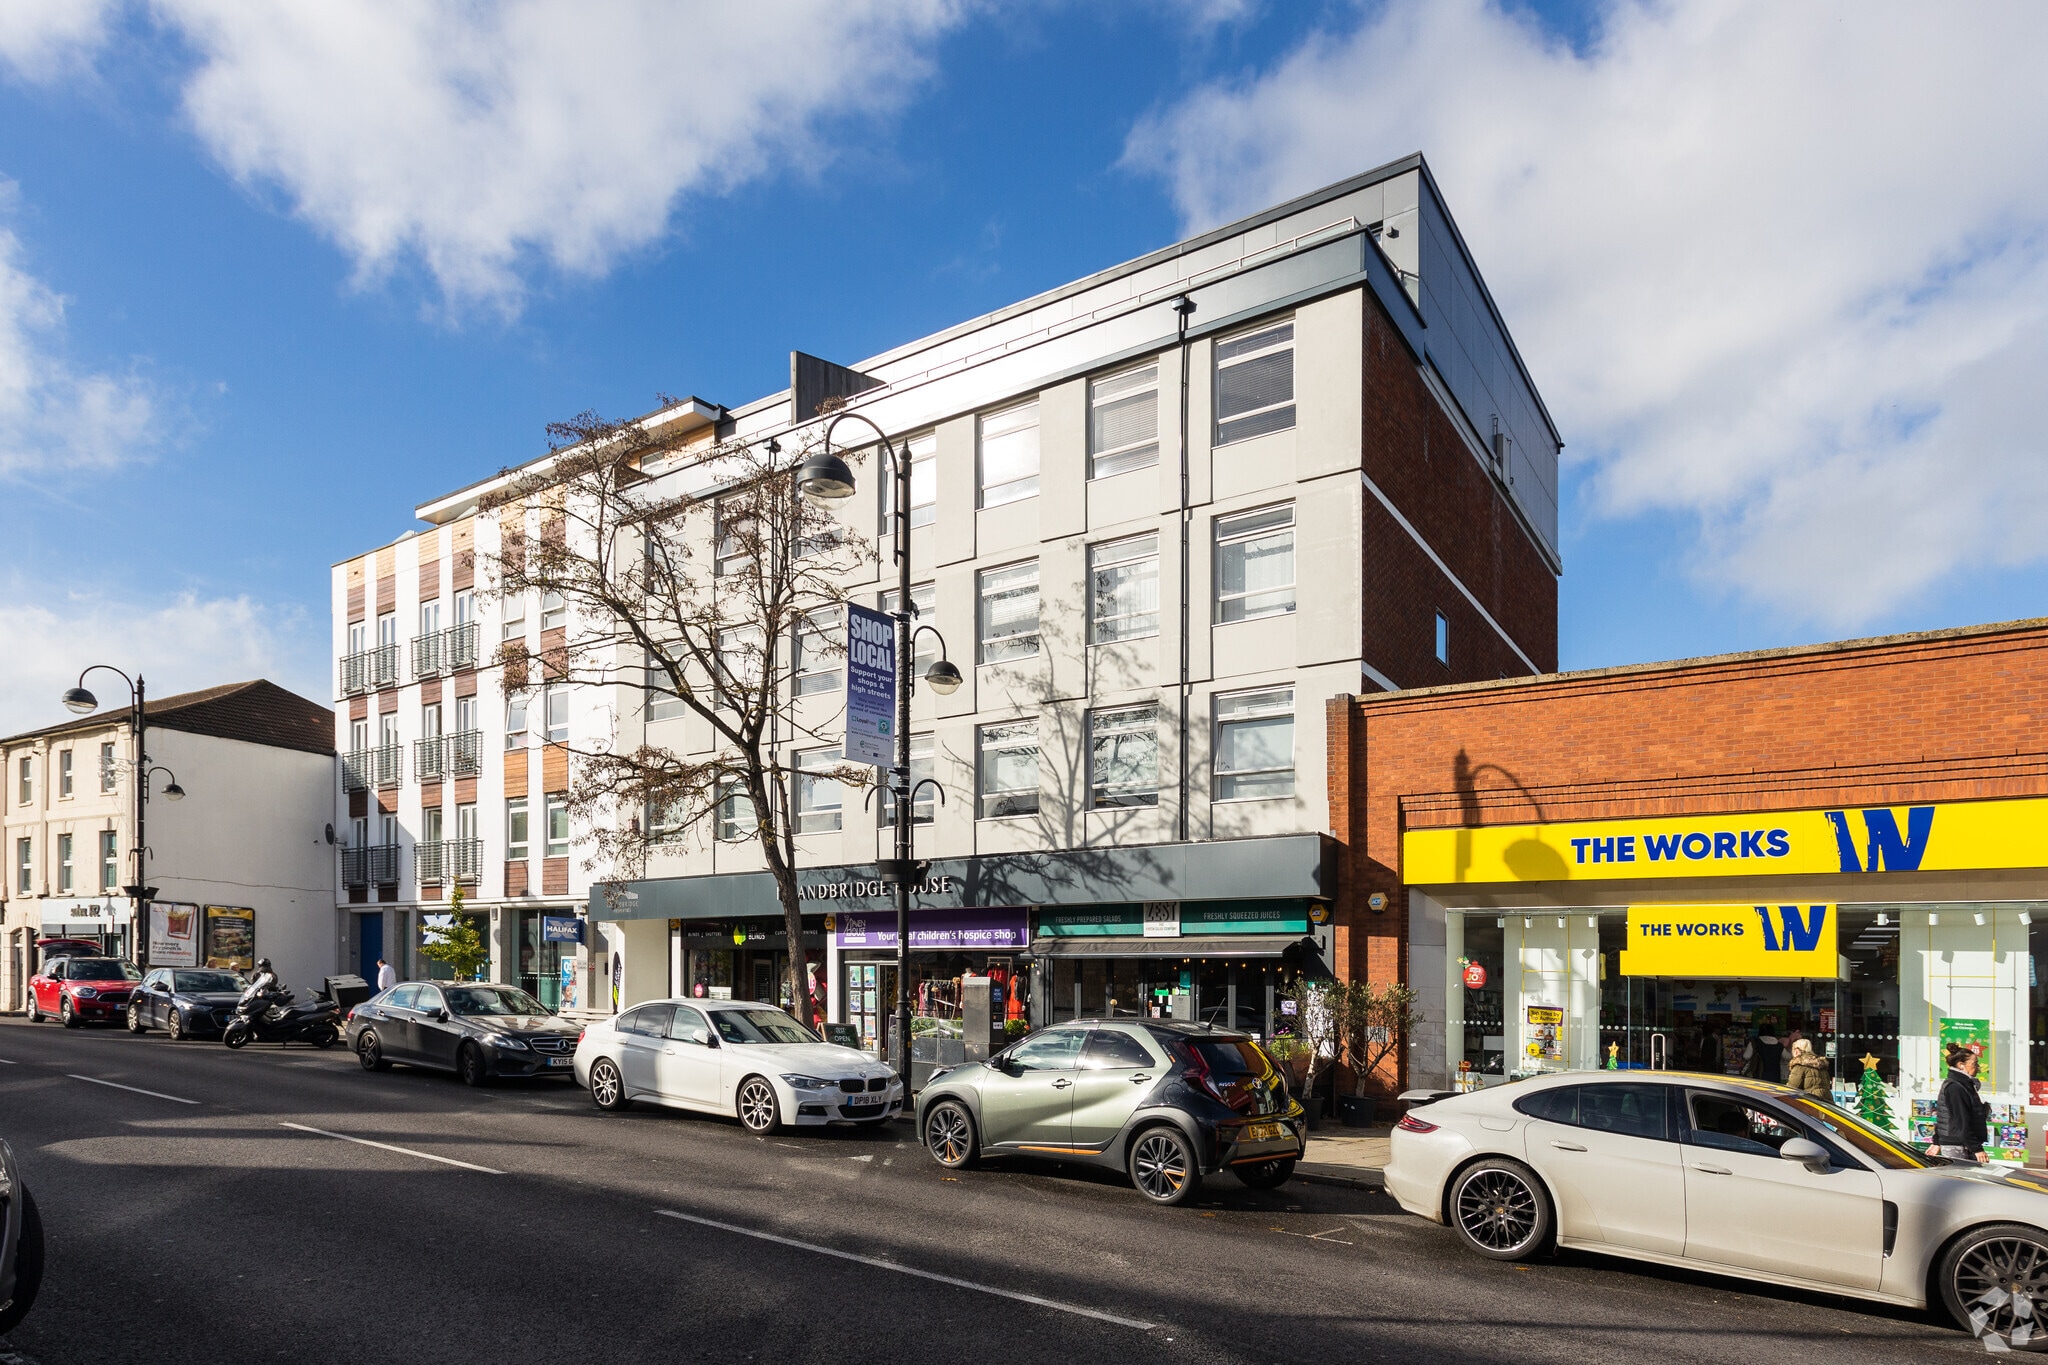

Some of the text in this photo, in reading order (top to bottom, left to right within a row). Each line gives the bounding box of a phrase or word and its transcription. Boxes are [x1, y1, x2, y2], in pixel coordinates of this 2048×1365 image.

[850, 614, 892, 647] SHOP
[850, 638, 893, 672] LOCAL
[850, 666, 892, 683] Support your
[858, 678, 877, 688] shops
[851, 684, 891, 700] high streets
[1571, 836, 1636, 864] THE
[1642, 828, 1791, 862] WORKS
[1146, 902, 1177, 921] ZEST
[1204, 912, 1228, 920] FRESHLY
[1260, 911, 1280, 919] JUICES
[546, 925, 578, 934] HALIFAX
[878, 932, 894, 941] Your
[918, 930, 956, 940] children's
[959, 929, 991, 941] hospice
[994, 928, 1016, 940] shop
[1640, 924, 1671, 936] THE
[1676, 922, 1745, 936] WORKS
[1466, 973, 1484, 982] JOY
[855, 1096, 870, 1104] DP18
